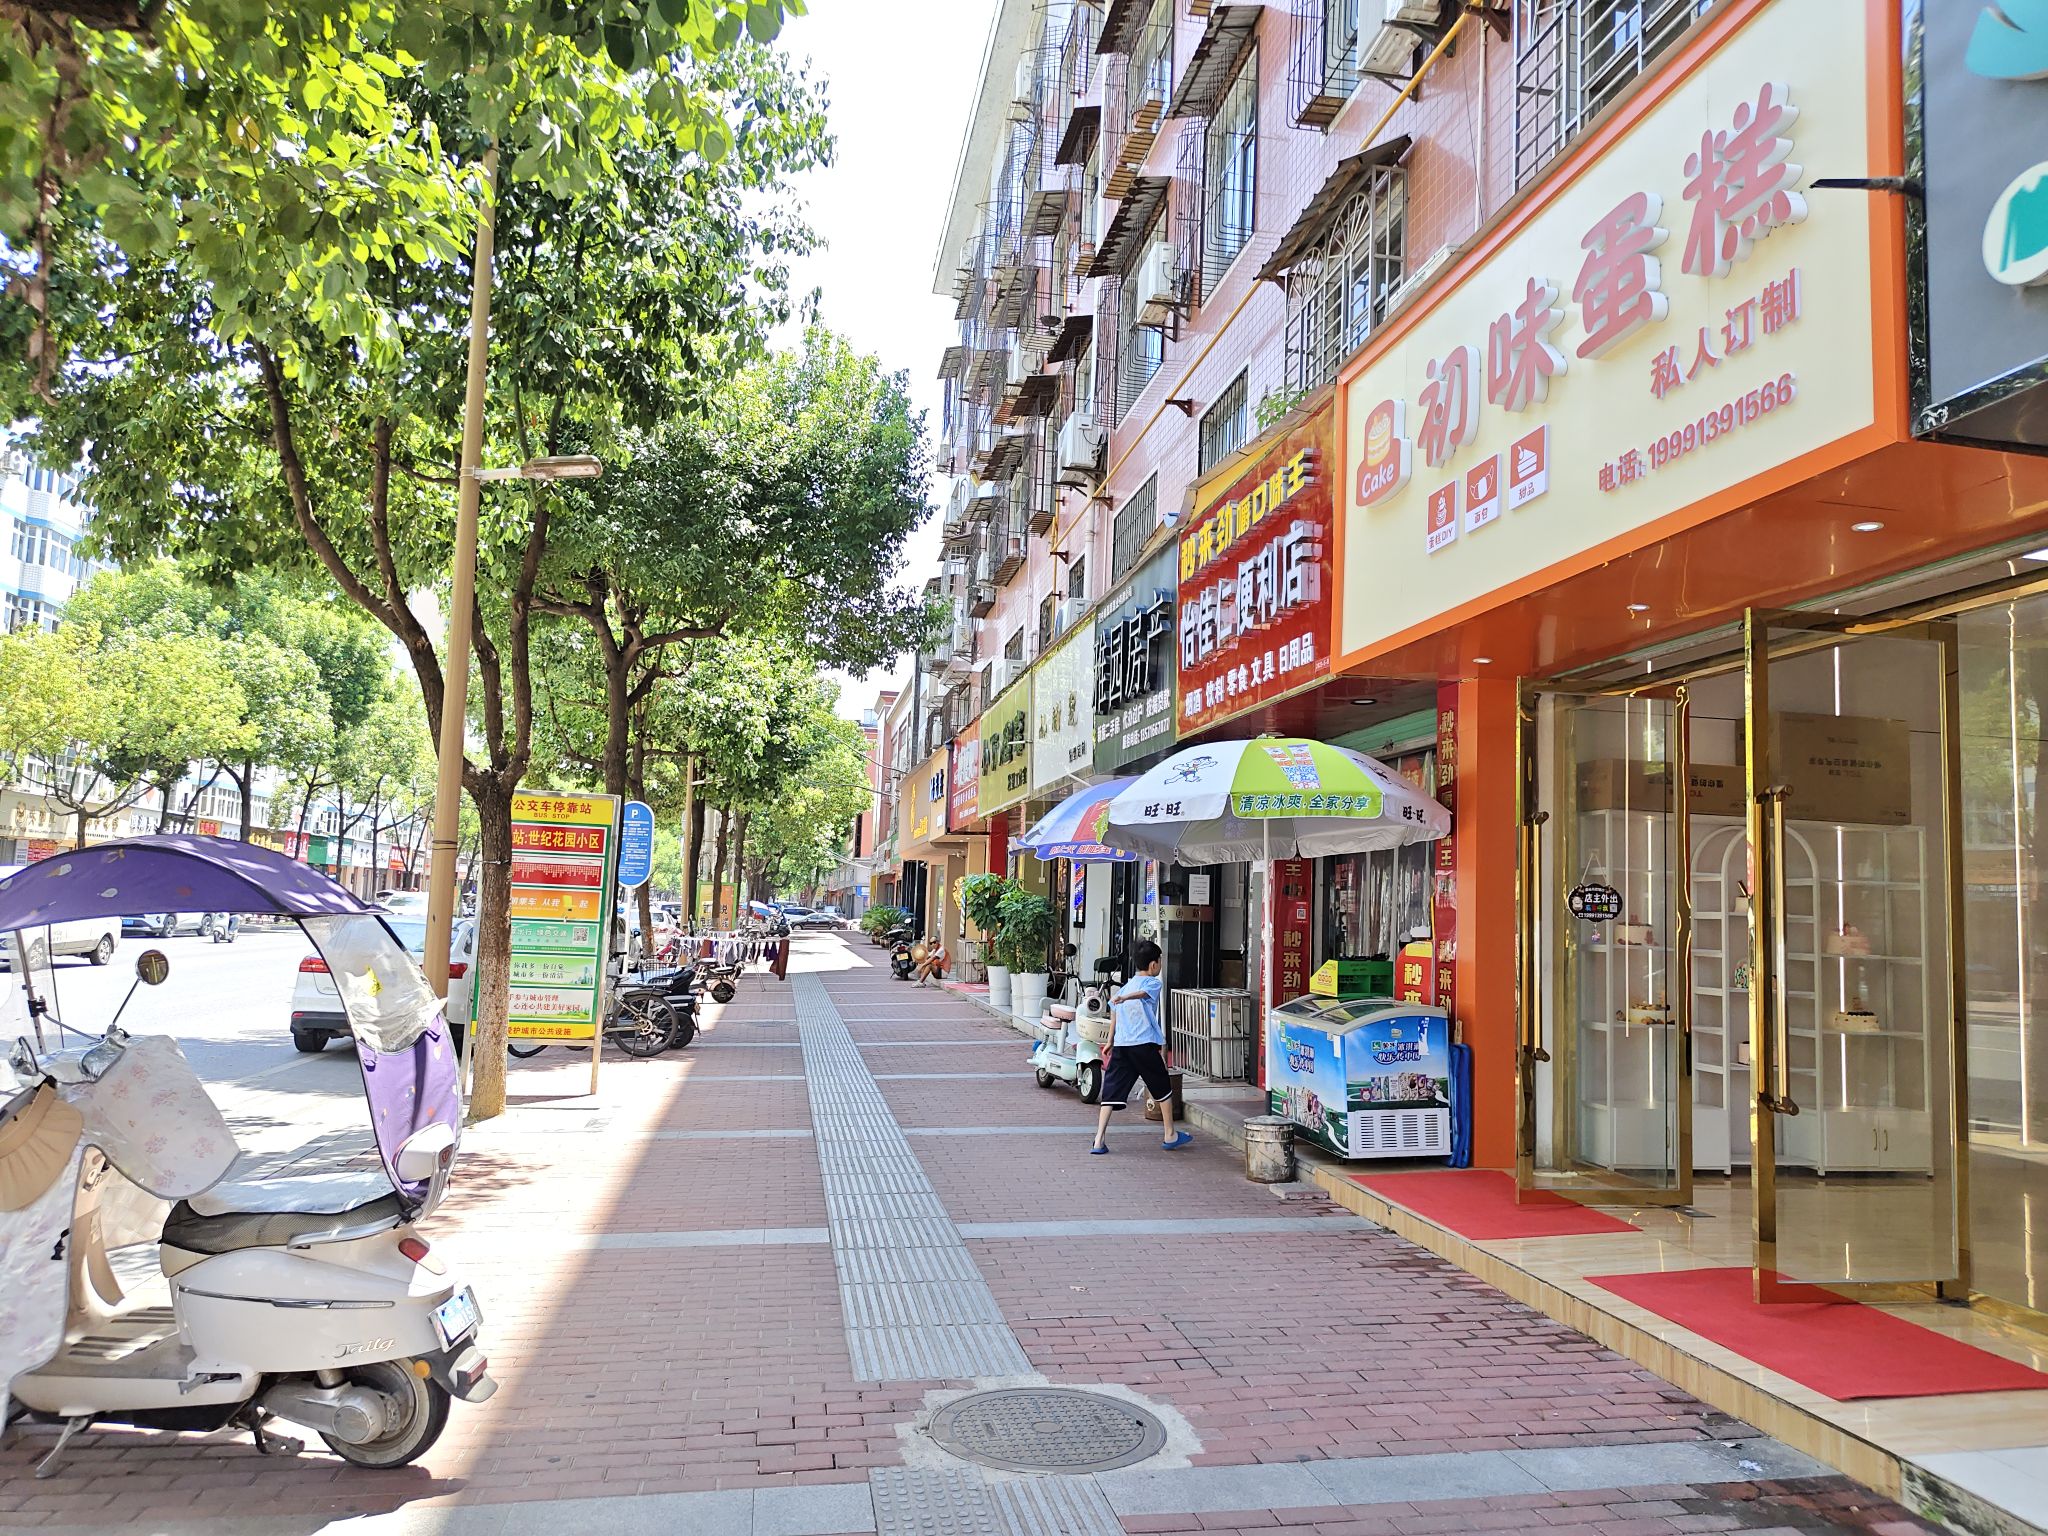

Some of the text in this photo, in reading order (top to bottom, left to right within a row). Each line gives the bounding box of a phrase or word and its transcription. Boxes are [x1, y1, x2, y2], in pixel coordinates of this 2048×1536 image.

[1417, 82, 1807, 467] 初味蛋糕
[1651, 268, 1800, 399] 私人订制
[1648, 373, 1795, 470] 19991391566
[1362, 461, 1395, 499] Cake
[1227, 664, 1248, 697] 零食
[1251, 651, 1274, 687] 文具
[1279, 632, 1314, 674] 日用品
[514, 799, 592, 814] 公交车停靠站
[631, 809, 639, 818] P
[1584, 893, 1618, 903] 店主外出
